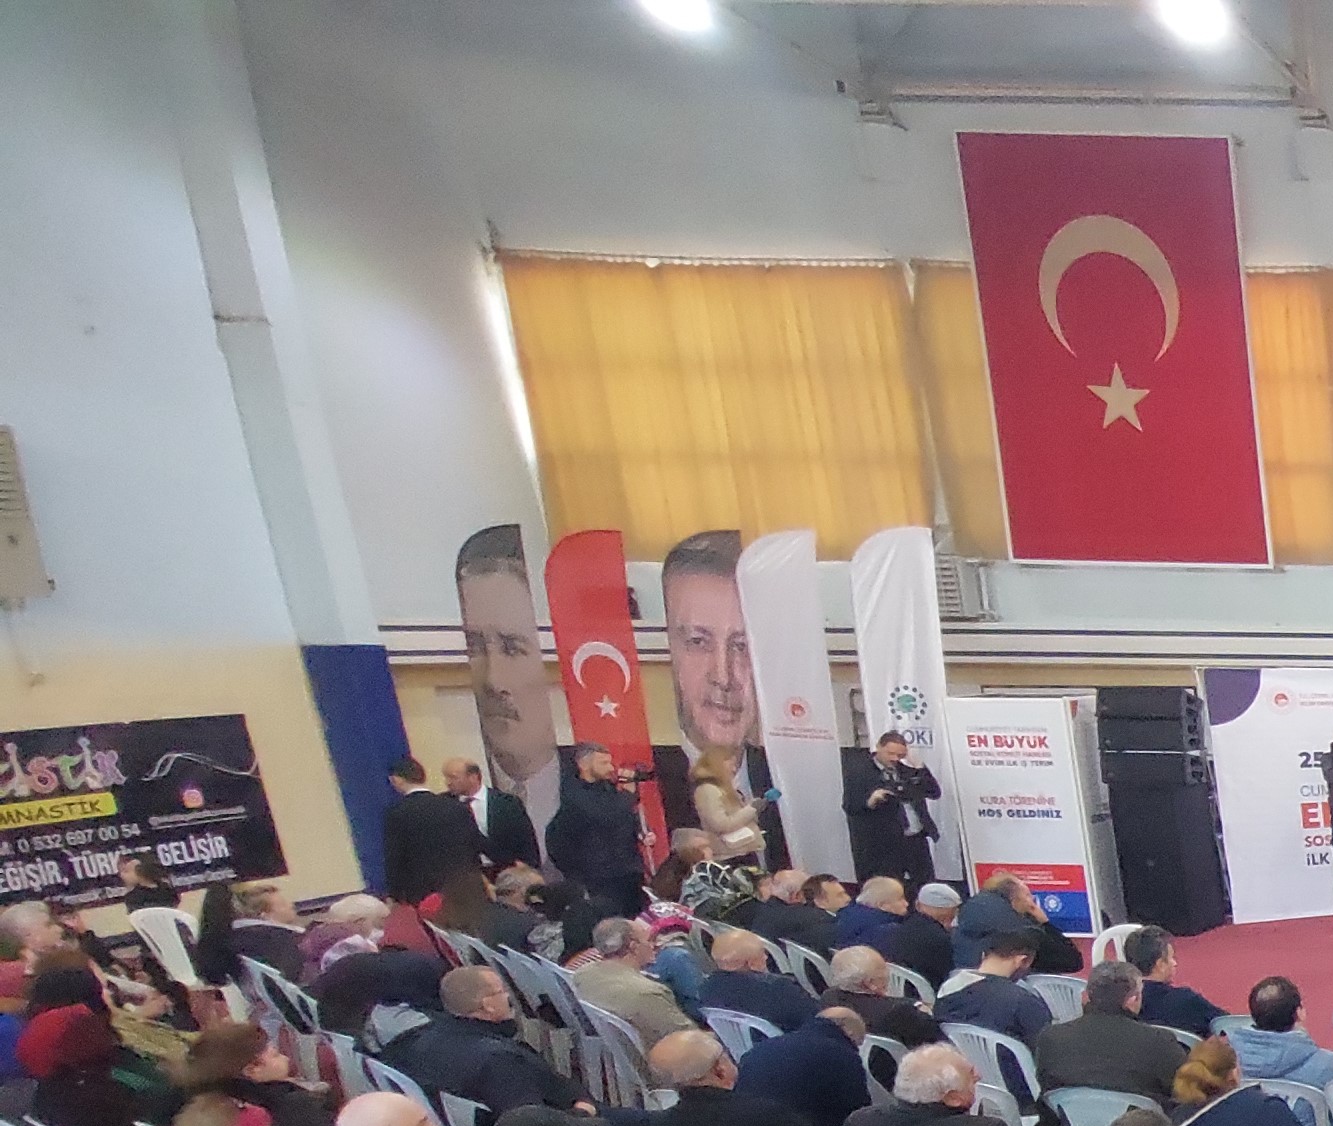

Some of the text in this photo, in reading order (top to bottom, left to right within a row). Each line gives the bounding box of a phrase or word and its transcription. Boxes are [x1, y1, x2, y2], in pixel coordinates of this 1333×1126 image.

[967, 735, 988, 748] EN
[980, 796, 1006, 805] KURA
[1007, 808, 1062, 819] GELDİNİZ
[157, 832, 230, 867] GELİŞİR
